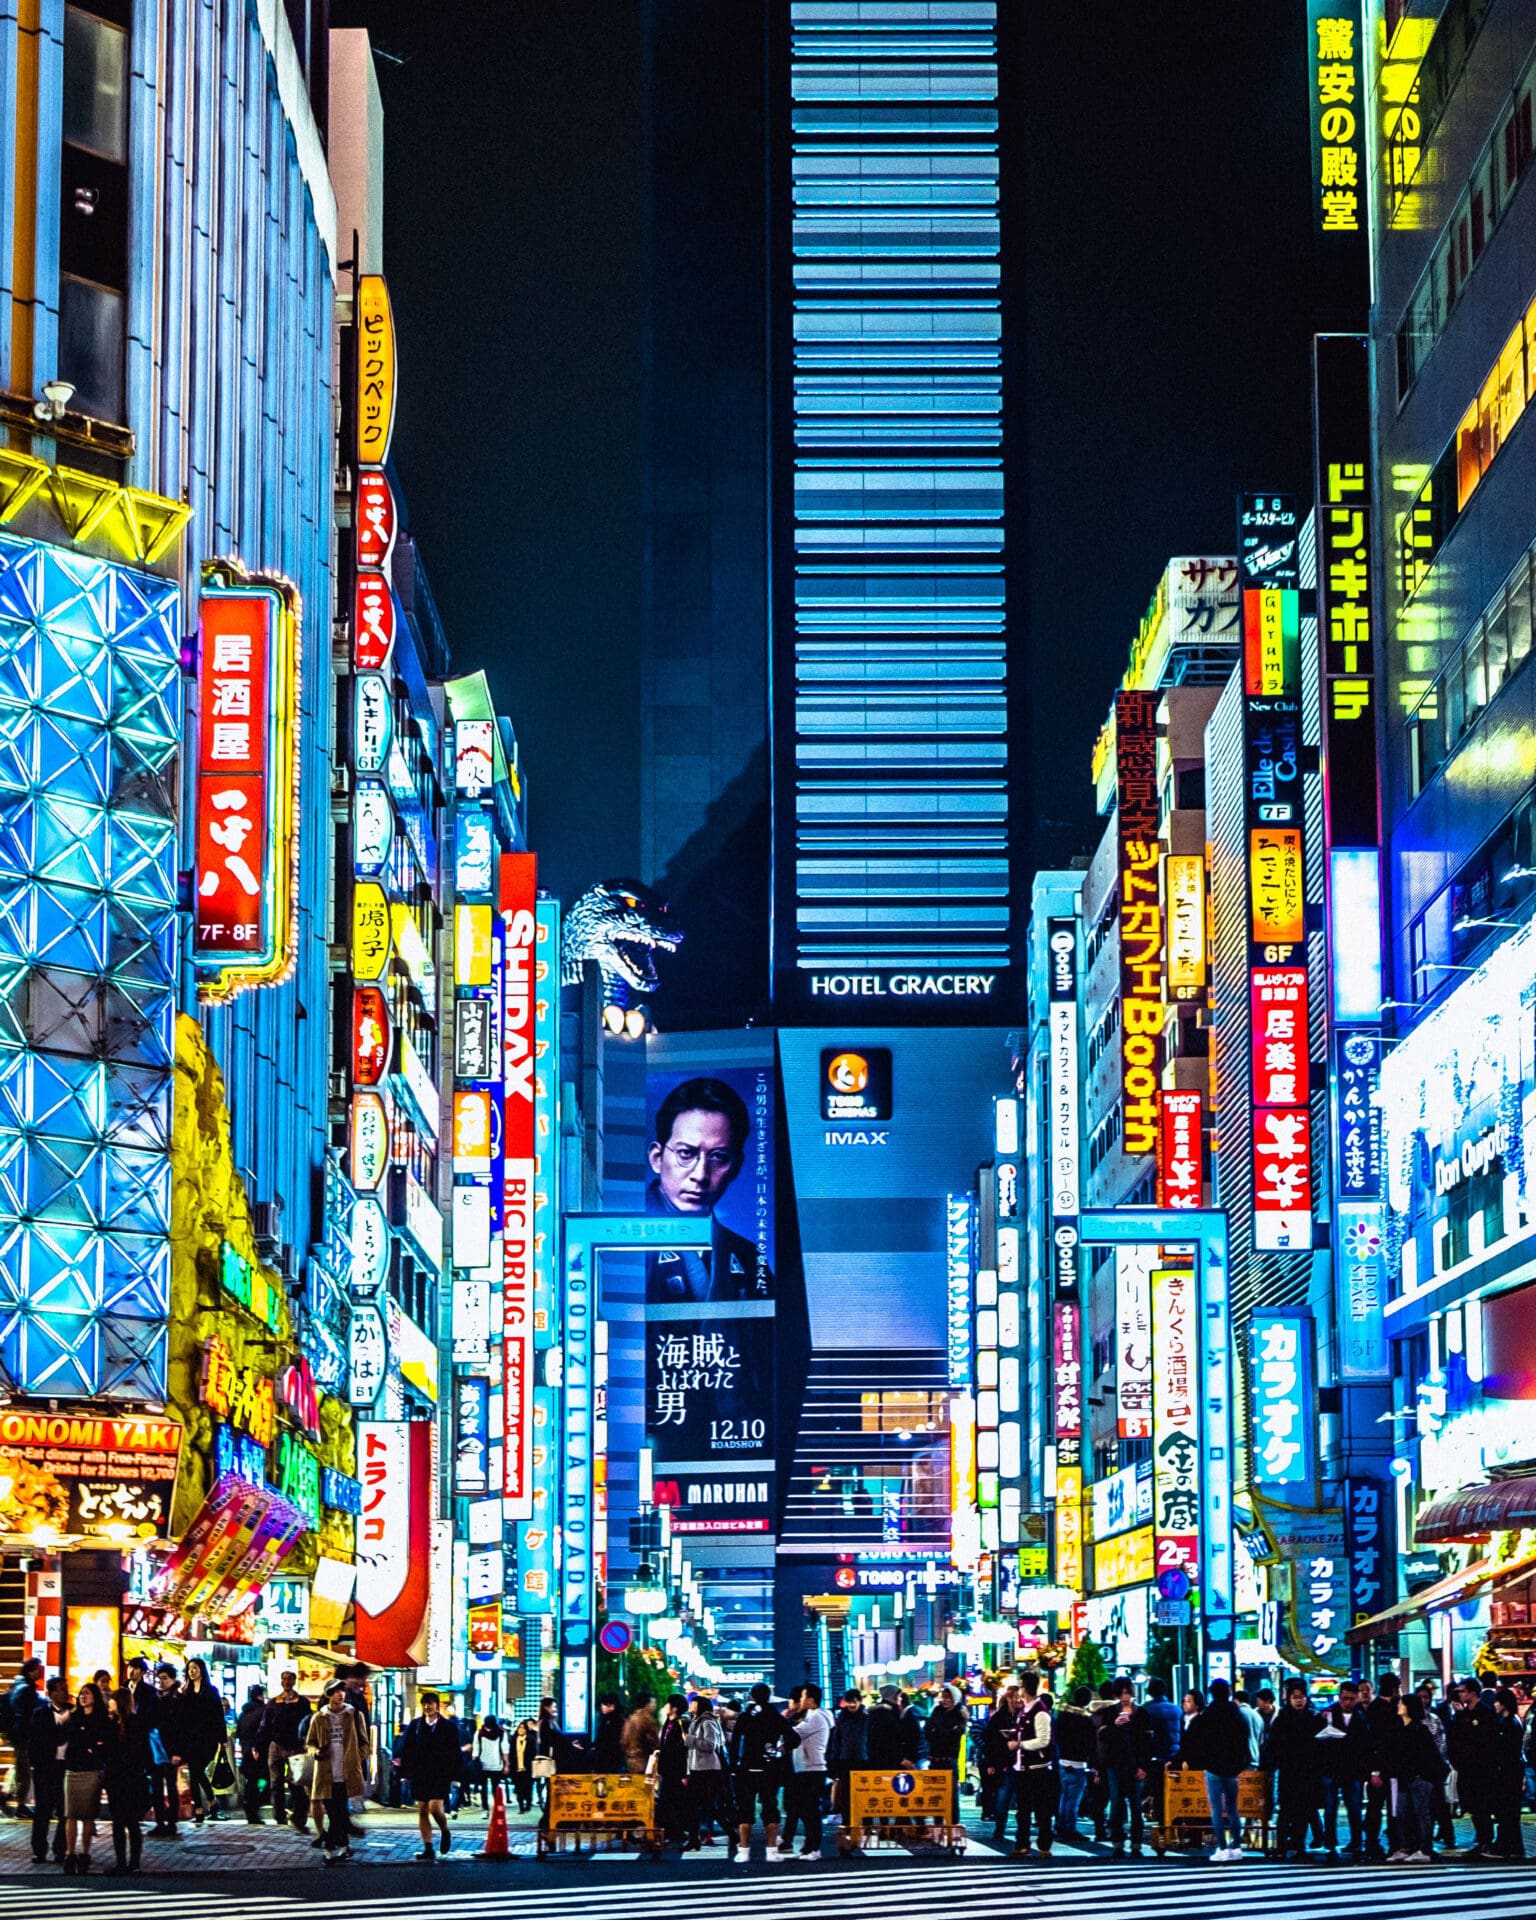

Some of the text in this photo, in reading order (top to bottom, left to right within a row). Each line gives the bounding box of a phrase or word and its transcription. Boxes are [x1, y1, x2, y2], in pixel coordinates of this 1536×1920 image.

[1316, 18, 1359, 230] 驚安の殿堂
[1328, 463, 1369, 719] ドン・キホーテ
[359, 655, 380, 665] 7F
[211, 635, 253, 760] 居酒屋
[1249, 702, 1299, 712] New Club
[358, 755, 382, 769] 6F
[1252, 758, 1276, 800] Elle
[1263, 807, 1288, 819] 7F
[361, 863, 377, 874] 5F
[1264, 944, 1294, 963] 6F
[811, 975, 996, 996] HOTEL GRACERY
[1177, 986, 1198, 1000] 6F
[502, 908, 535, 1103] SHIDAX
[825, 1131, 889, 1145] IMAX
[1435, 1157, 1460, 1196] Don
[503, 1178, 526, 1326] BIC DRUG
[355, 1285, 374, 1296] 1F
[655, 1333, 742, 1369] 海賊と
[1352, 1339, 1377, 1357] 5F
[655, 1368, 735, 1390] よばれた
[355, 1386, 374, 1397] B1
[1260, 1324, 1301, 1476] カラオケ
[655, 1391, 687, 1426] 男
[112, 1422, 181, 1450] YAKI
[567, 1279, 587, 1586] GODZILLA ROAD
[710, 1419, 766, 1441] 12.10
[1125, 1417, 1152, 1438] B1
[45, 1448, 82, 1461] dinner
[83, 1450, 107, 1463] with
[710, 1440, 764, 1450] ROADSHOW
[1058, 1438, 1080, 1451] 4F
[1058, 1451, 1080, 1464] 3F
[43, 1461, 79, 1475] Drinks
[80, 1463, 97, 1476] for
[98, 1465, 106, 1477] 2
[107, 1465, 139, 1478] hours
[1158, 1431, 1198, 1530] 金の蔵
[363, 1433, 388, 1541] トラノコ
[687, 1482, 769, 1505] MARUHAN
[1158, 1539, 1191, 1567] 2F
[1352, 1485, 1382, 1606] カラオケ
[858, 1571, 904, 1586] TOHO
[1309, 1557, 1339, 1656] カラオケ
